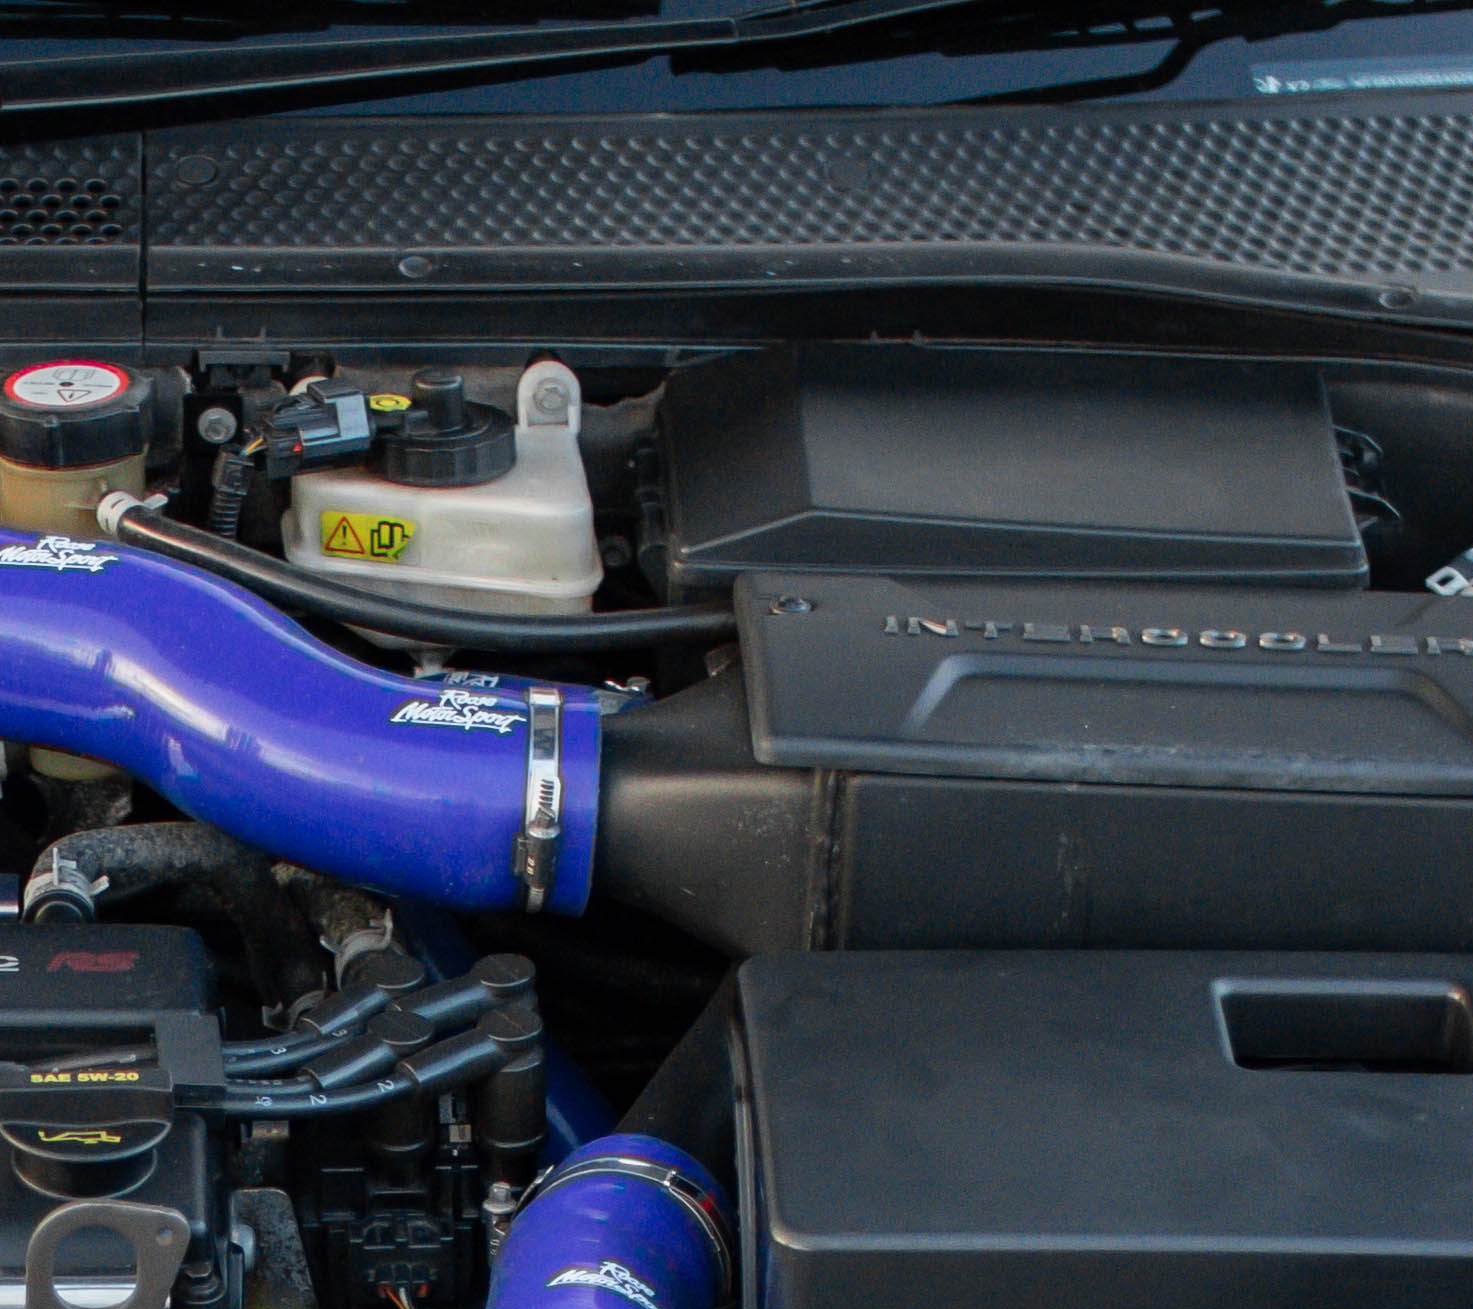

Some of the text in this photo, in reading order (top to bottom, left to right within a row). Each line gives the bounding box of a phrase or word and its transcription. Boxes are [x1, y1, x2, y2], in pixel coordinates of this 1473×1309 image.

[47, 951, 141, 972] RS
[30, 1071, 140, 1084] SAE 5W-20
